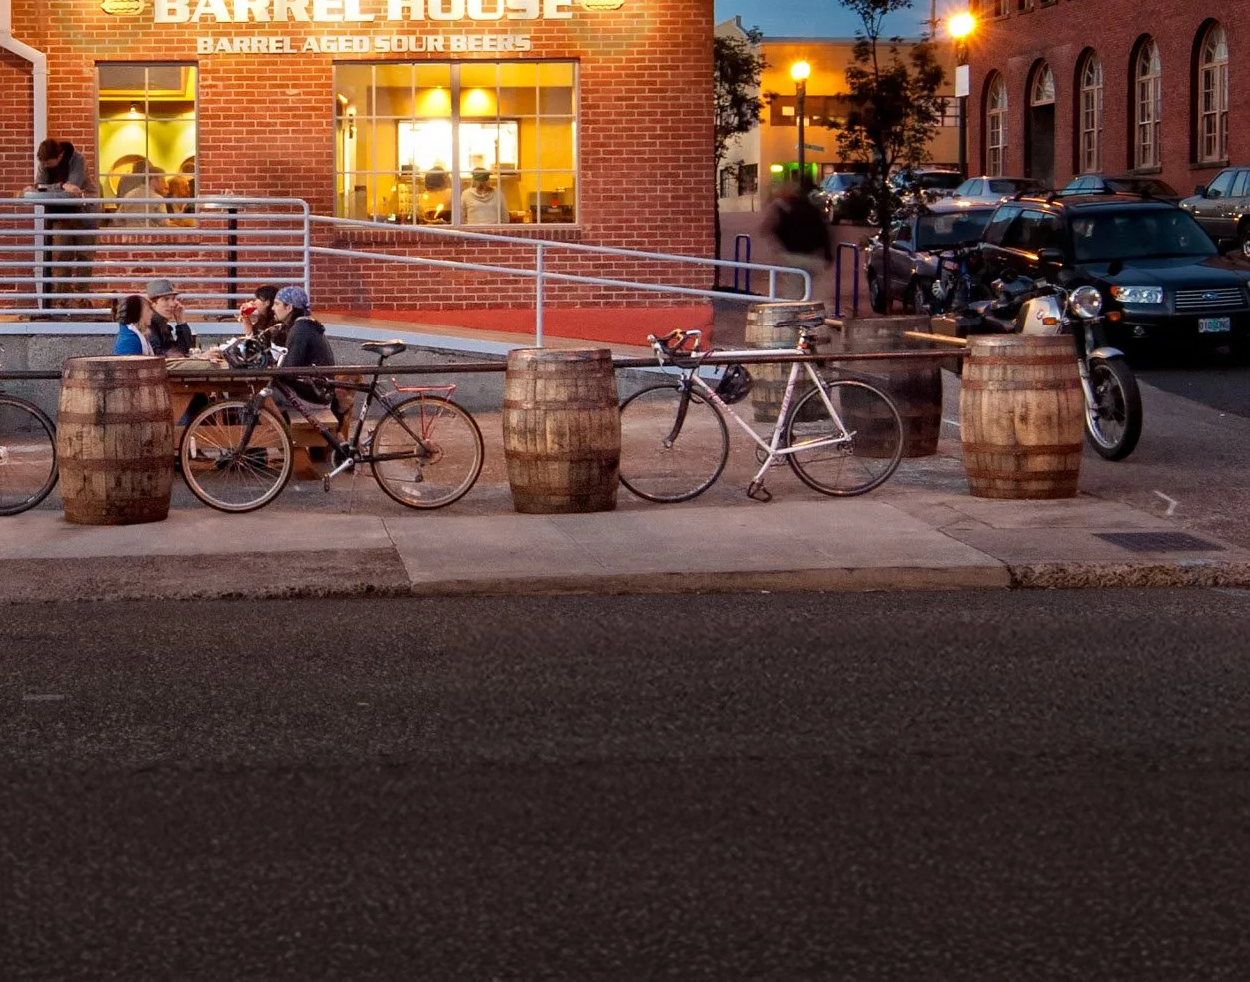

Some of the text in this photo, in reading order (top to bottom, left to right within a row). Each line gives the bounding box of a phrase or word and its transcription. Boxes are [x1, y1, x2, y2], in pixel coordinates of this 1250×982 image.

[196, 34, 532, 55] BARREL AGED SOUR BEERS
